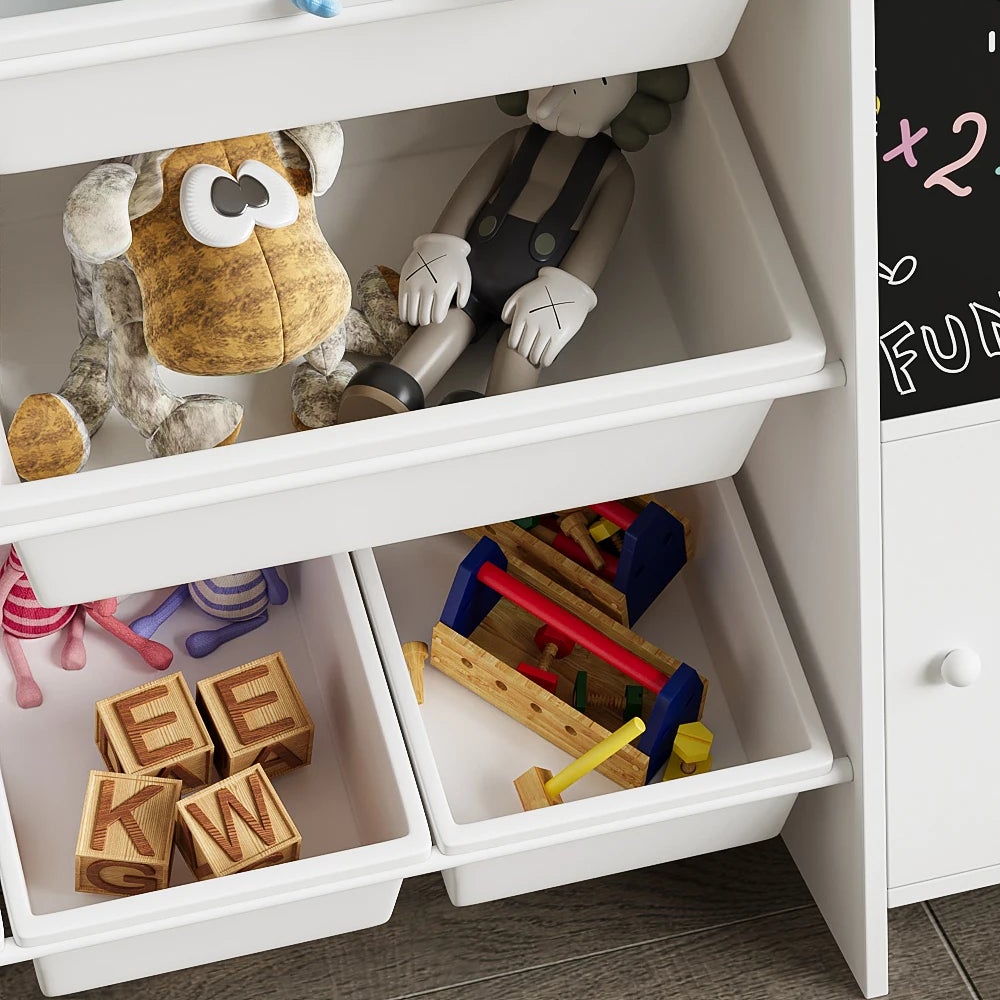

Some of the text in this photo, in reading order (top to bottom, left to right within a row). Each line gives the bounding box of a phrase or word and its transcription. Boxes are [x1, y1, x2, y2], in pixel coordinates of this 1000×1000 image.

[114, 684, 194, 766] E
[215, 665, 295, 746] E
[90, 779, 164, 857] K
[186, 774, 276, 862] W
